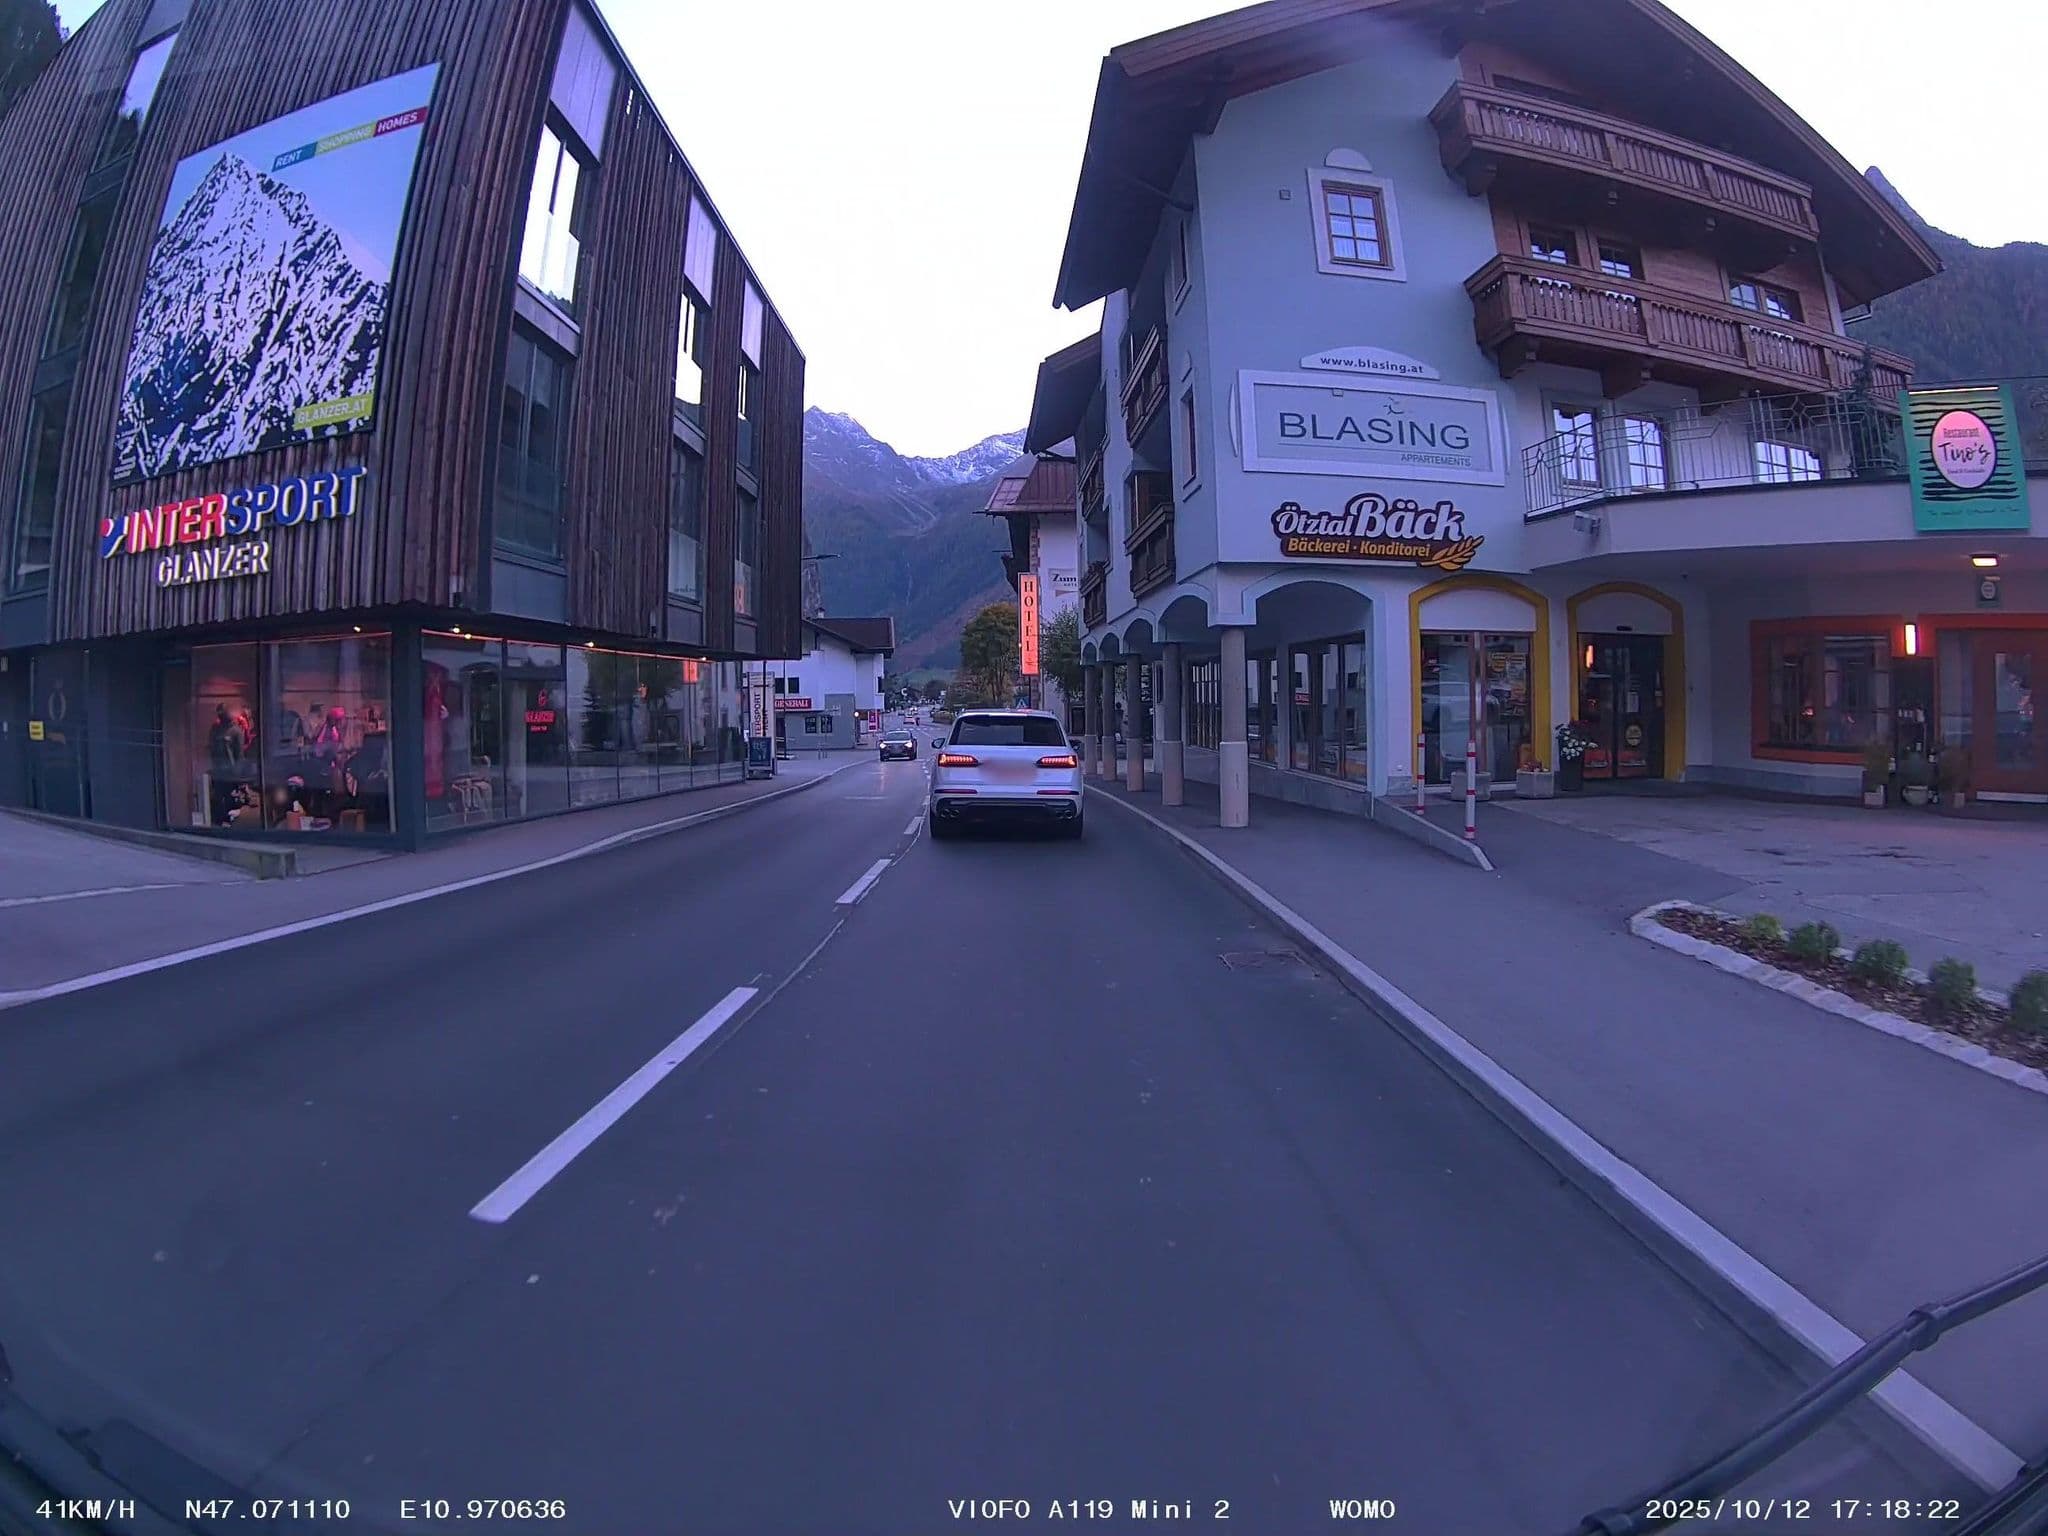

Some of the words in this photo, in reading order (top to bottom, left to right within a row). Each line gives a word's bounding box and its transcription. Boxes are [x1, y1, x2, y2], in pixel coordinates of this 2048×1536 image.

[275, 149, 303, 168] RENT
[318, 126, 372, 152] SHOPPING
[377, 111, 418, 134] HOMES
[1320, 357, 1424, 374] www.blasing.at
[298, 398, 368, 424] GLANZER.AT
[1279, 411, 1470, 450] BLASING
[1943, 427, 1980, 438] Restaurant
[1400, 453, 1471, 467] APPARTEMENTS
[1938, 441, 1992, 465] Tino's
[126, 465, 368, 554] INTERSPORT
[1275, 505, 1353, 536] Ötztal
[1349, 496, 1466, 542] Bäck
[1287, 538, 1350, 554] Bäckerei
[1359, 540, 1431, 557] Konditorei
[157, 540, 270, 588] GLANZER
[1052, 573, 1077, 582] Zum
[1023, 580, 1035, 653] HOTEL
